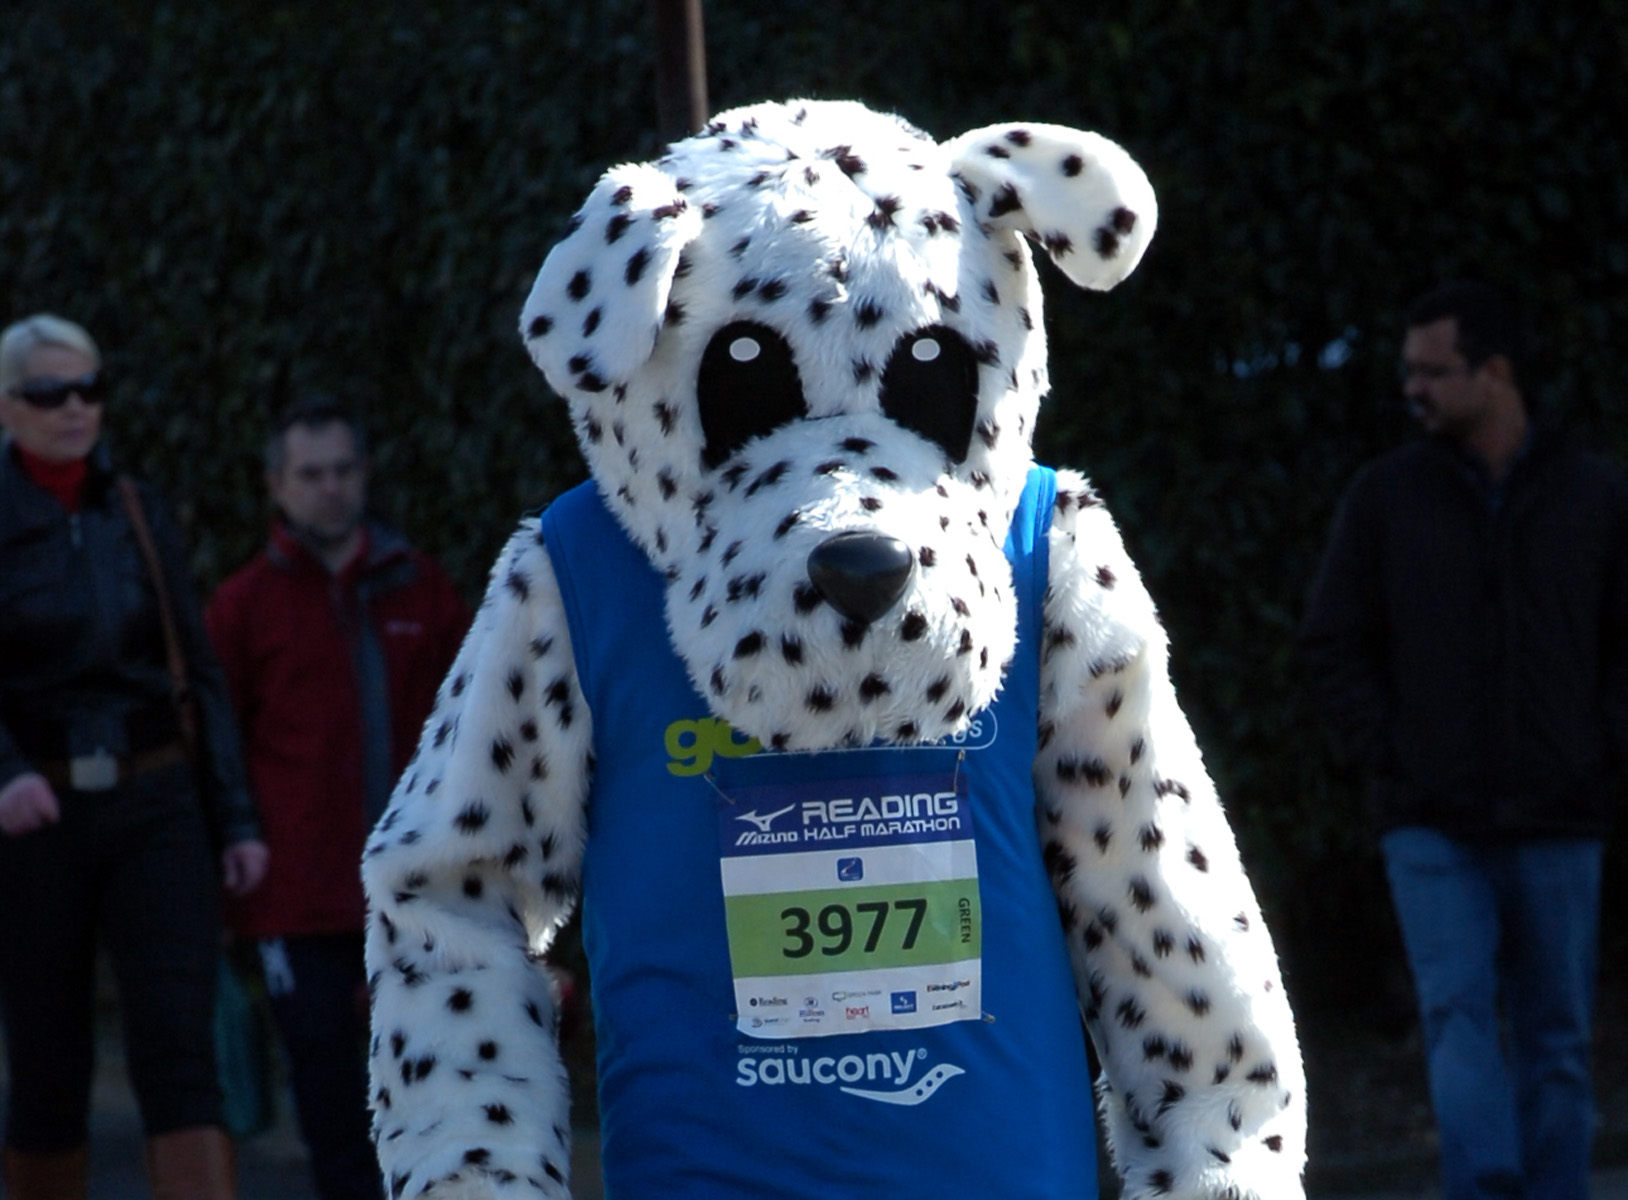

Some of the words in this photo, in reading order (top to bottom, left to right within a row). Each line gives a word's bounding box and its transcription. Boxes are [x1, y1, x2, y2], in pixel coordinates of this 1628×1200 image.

[802, 793, 958, 825] READING
[804, 825, 856, 841] HALF
[861, 818, 960, 837] MARATHON
[780, 898, 927, 959] 3977
[958, 897, 971, 943] GREEN
[738, 1044, 785, 1055] Sponsored
[787, 1044, 798, 1055] by
[736, 1049, 916, 1086] saucony
